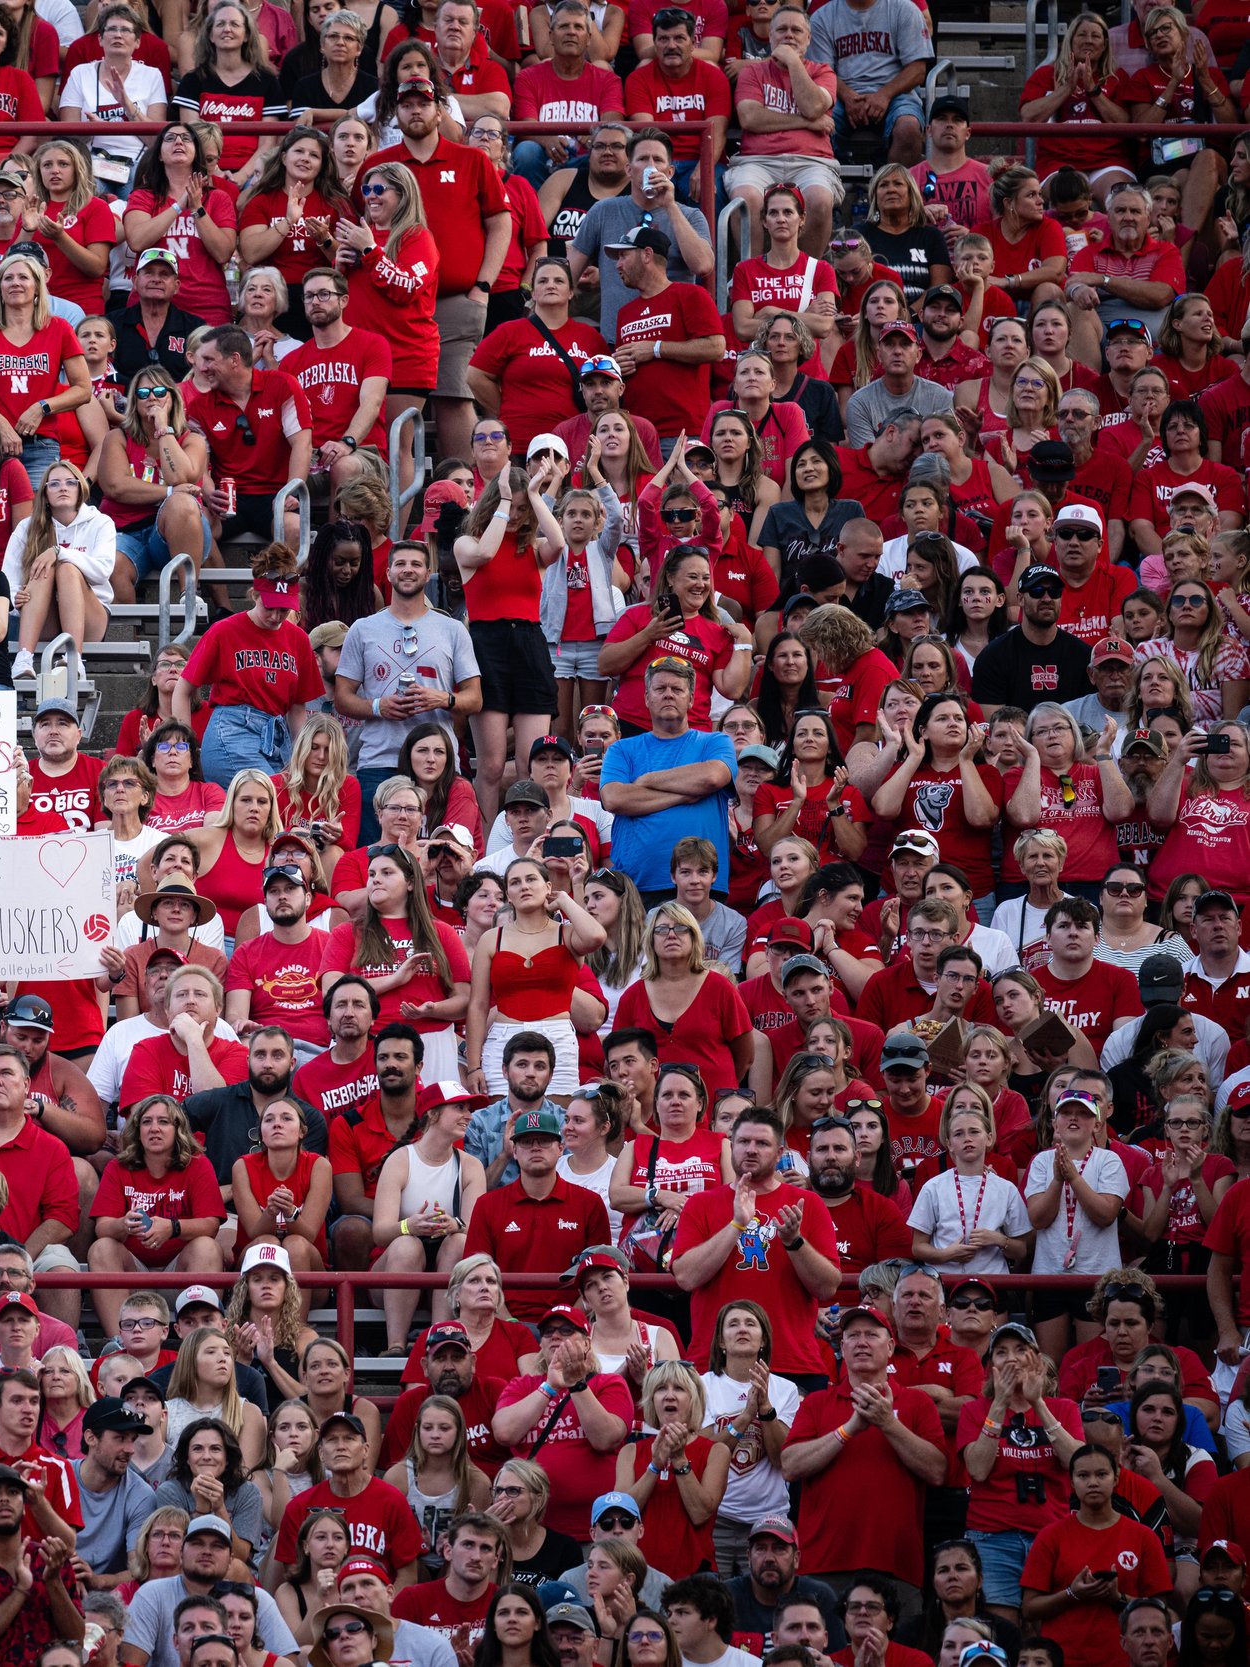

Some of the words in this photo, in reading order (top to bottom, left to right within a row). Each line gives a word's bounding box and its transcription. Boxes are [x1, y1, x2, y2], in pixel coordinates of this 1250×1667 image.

[834, 33, 891, 58] NEBRASKA
[462, 74, 473, 84] N
[200, 102, 255, 117] Nebraska
[440, 170, 454, 182] N
[166, 237, 190, 259] N
[292, 240, 305, 251] N
[910, 249, 927, 262] N
[755, 278, 781, 287] THE
[752, 291, 773, 302] BIG
[168, 336, 184, 352] N
[298, 362, 358, 389] NEBRASKA
[10, 376, 29, 393] N
[275, 582, 288, 593] N
[985, 596, 991, 604] N
[1106, 642, 1118, 650] N
[690, 651, 709, 665] STATE
[264, 672, 276, 683] N
[1031, 665, 1059, 690] N
[544, 736, 557, 744] N
[1135, 730, 1149, 739] N
[55, 792, 90, 810] BIG
[1180, 798, 1248, 826] Nebraska
[1134, 850, 1149, 865] N
[275, 964, 310, 978] SANDY
[1236, 986, 1250, 998] N
[526, 1112, 540, 1128] N
[744, 1238, 754, 1247] N
[259, 1247, 277, 1261] GBR
[584, 1257, 593, 1266] N
[938, 1362, 952, 1373] N
[1002, 1447, 1042, 1459] VOLLEYBALL
[1214, 1540, 1228, 1548] N
[1122, 1553, 1134, 1566] N
